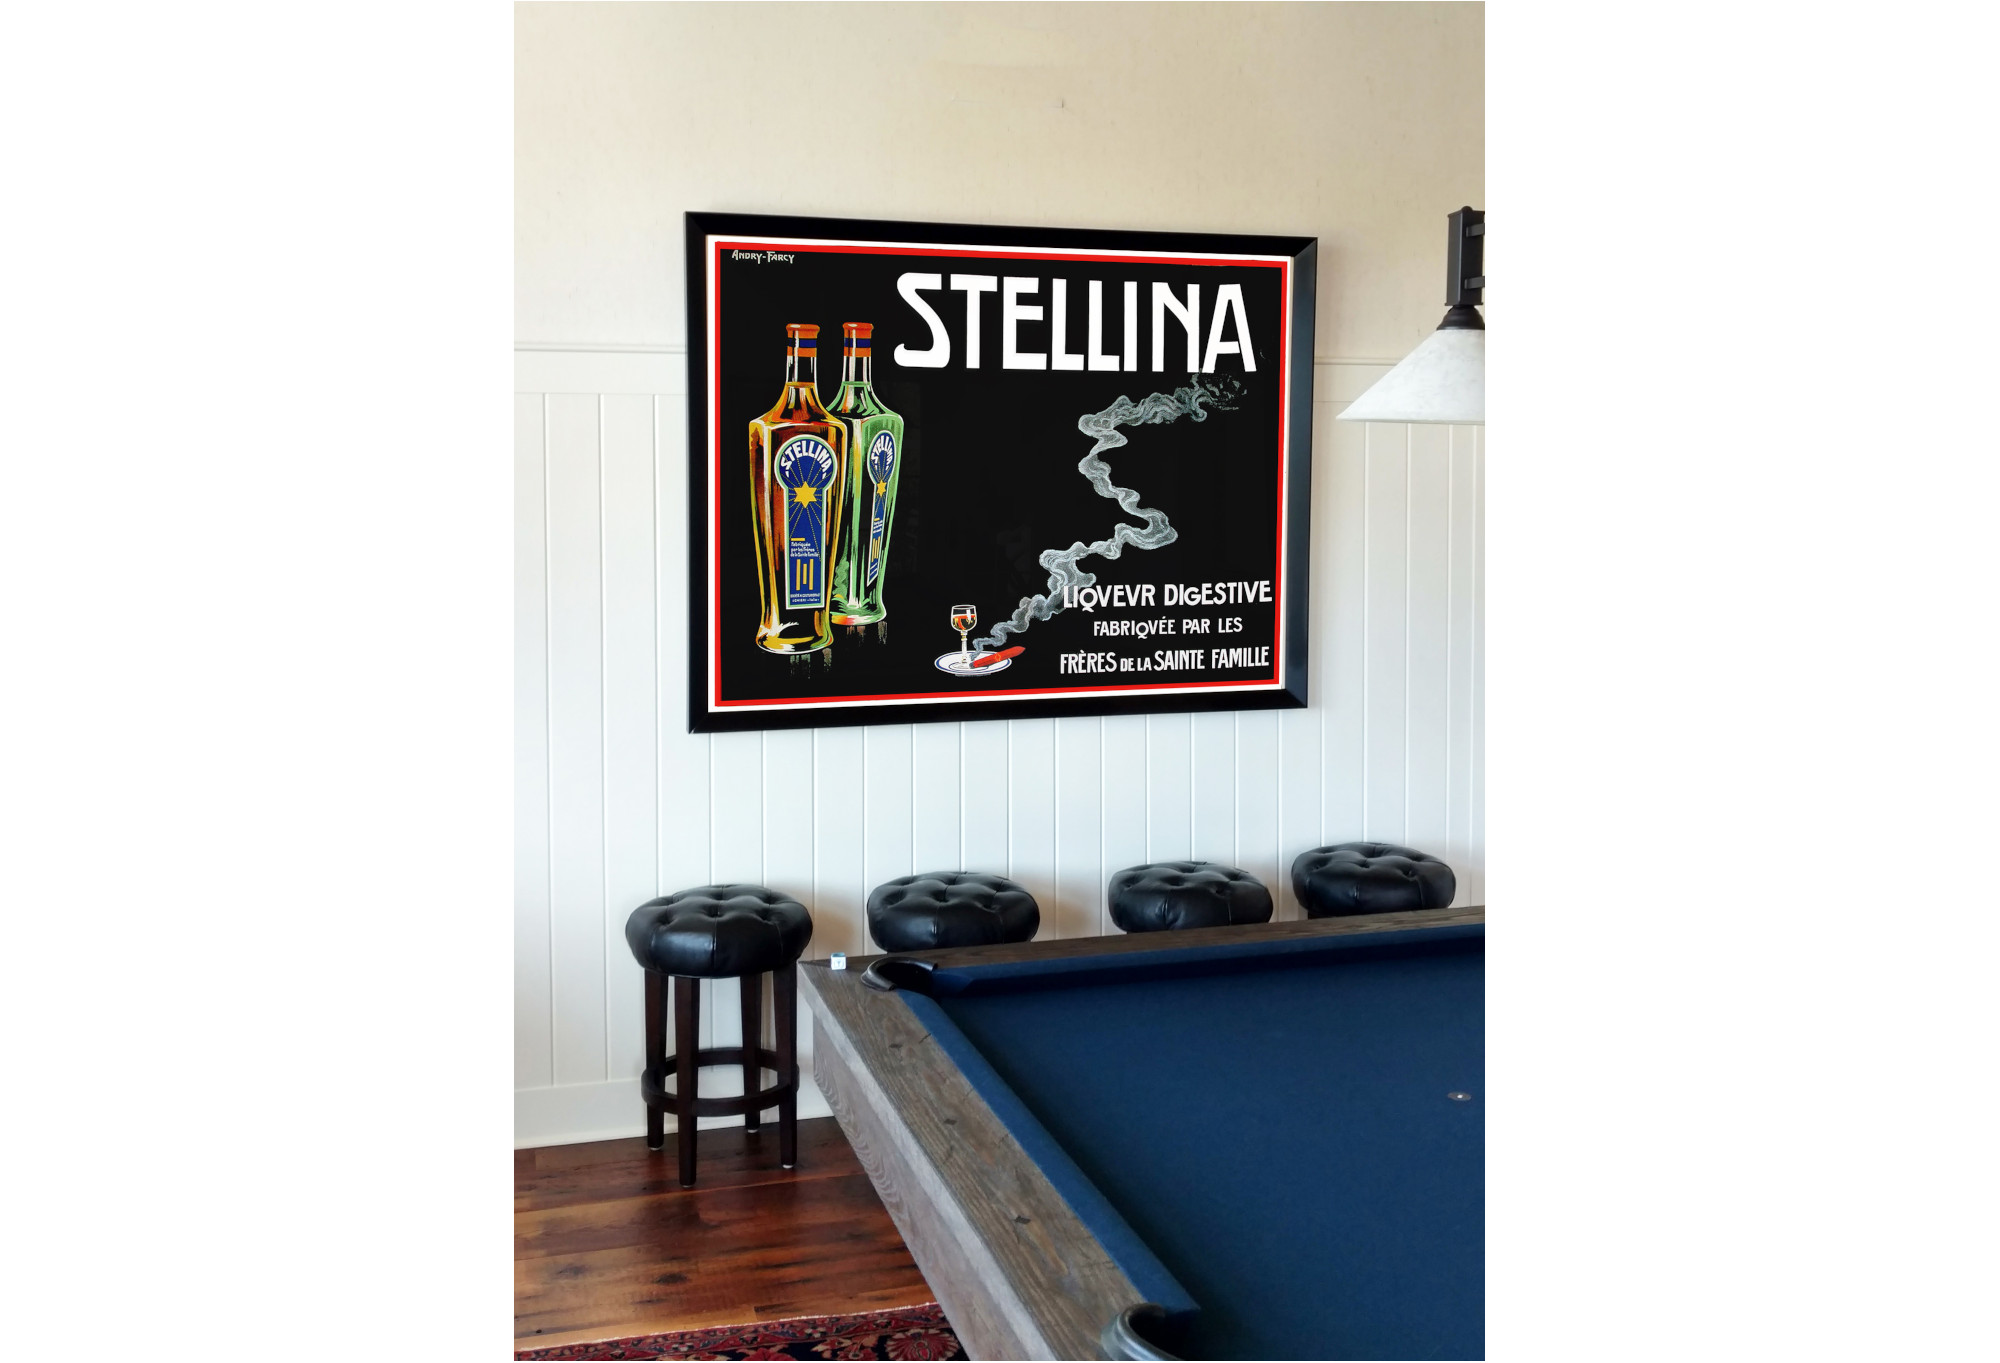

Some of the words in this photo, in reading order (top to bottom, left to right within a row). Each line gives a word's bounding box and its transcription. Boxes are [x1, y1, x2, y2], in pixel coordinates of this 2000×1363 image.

[894, 272, 1257, 374] STELLINA
[780, 440, 833, 472] STELLINA
[870, 435, 893, 465] STELLINA
[1164, 580, 1273, 606] DIGESTIVE
[1182, 618, 1210, 634] PAR
[1218, 617, 1243, 633] LES
[1060, 650, 1117, 674] FRÈRES
[1120, 658, 1135, 672] DE
[1137, 657, 1152, 672] LA
[1154, 649, 1205, 671] SAINTE
[1211, 646, 1270, 669] FAMILLE
